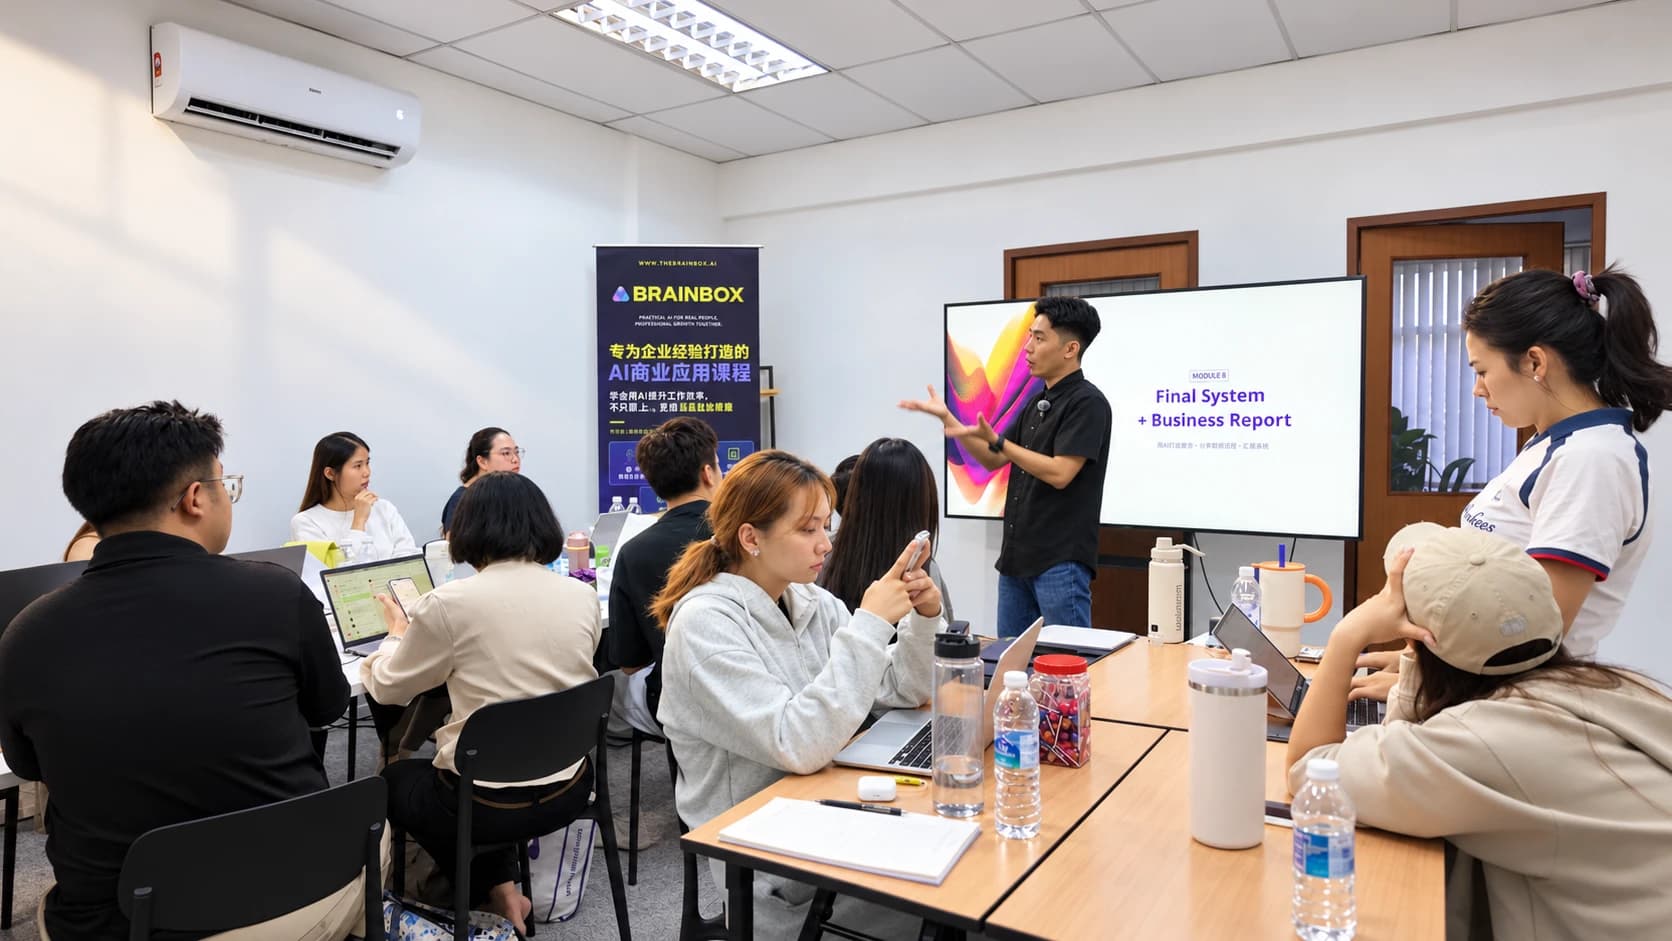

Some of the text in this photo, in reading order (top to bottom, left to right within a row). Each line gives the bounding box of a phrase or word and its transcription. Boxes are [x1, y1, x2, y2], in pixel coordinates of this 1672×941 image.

[633, 286, 744, 302] BRAINBOX
[608, 362, 751, 382] AI商业应用课程
[1156, 388, 1265, 406] Final System
[1138, 413, 1292, 431] + Business Report
